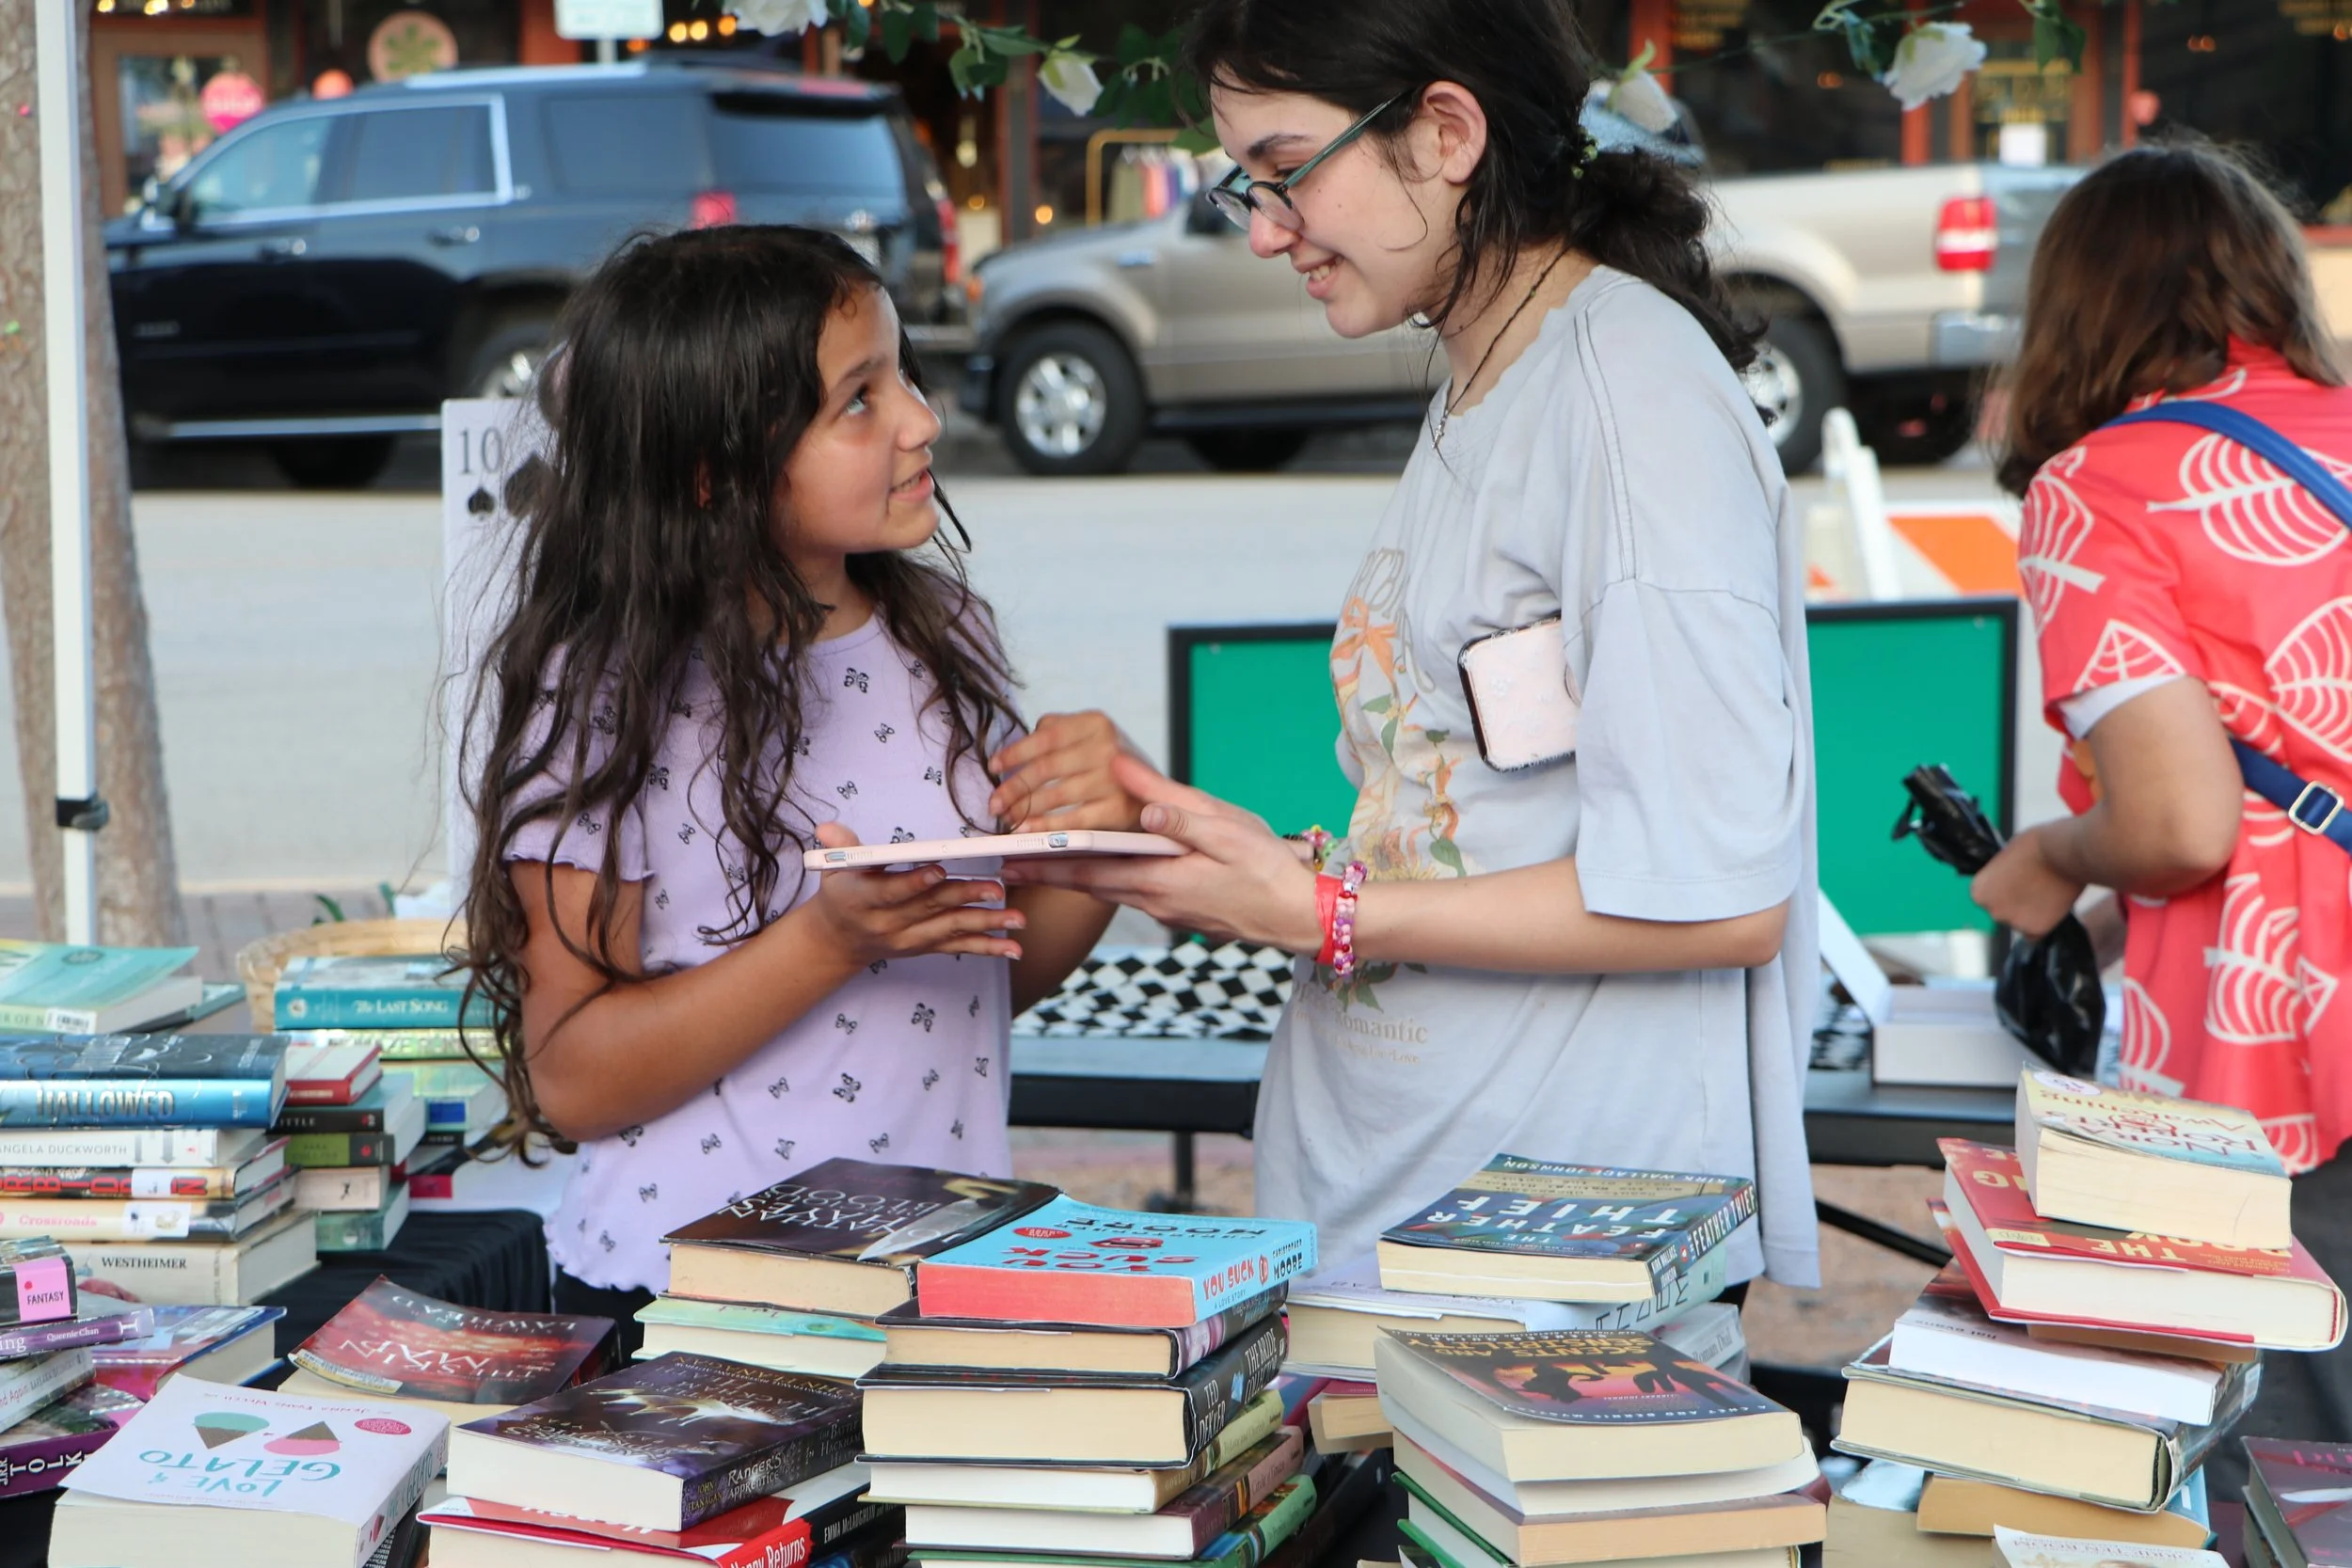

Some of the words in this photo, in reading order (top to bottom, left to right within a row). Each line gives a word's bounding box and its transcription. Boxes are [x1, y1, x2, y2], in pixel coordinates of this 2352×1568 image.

[459, 428, 502, 475] 10
[377, 1000, 405, 1014] LAST
[408, 998, 449, 1014] SONG
[36, 1087, 176, 1118] HALLOWED
[48, 1145, 127, 1155] DUCKWORTH
[2077, 1124, 2230, 1157] NORA
[1503, 1159, 1586, 1175] JOHNSON
[1594, 1169, 1676, 1182] WALLACE
[1683, 1175, 1727, 1184] KIRK
[19, 1214, 97, 1227] Crossroads
[1456, 1196, 1680, 1225] THIEF
[1692, 1205, 1732, 1257] FEATHER
[1730, 1185, 1756, 1225] THIEF
[1065, 1216, 1267, 1235] MOORE
[1425, 1211, 1668, 1240] FEATHER
[1272, 1238, 1303, 1259] CHRISTOPHER
[1501, 1233, 1552, 1243] THE
[1001, 1245, 1200, 1264] SUCK
[2084, 1237, 2188, 1262] THE
[102, 1257, 186, 1270] WESTHEIMER
[1001, 1259, 1152, 1273] YOU
[1273, 1252, 1303, 1280] MOORE
[1203, 1272, 1225, 1301] YOU
[1227, 1257, 1255, 1289] SUCK
[27, 1291, 64, 1306] FANTASY
[1218, 1295, 1231, 1308] LOVE
[1232, 1289, 1247, 1301] STORY
[47, 1329, 78, 1342] Queenie
[79, 1327, 99, 1338] Chan
[1405, 1338, 1655, 1350] SENSIBILITY
[361, 1339, 491, 1370] MAP
[1245, 1343, 1260, 1375] THE
[1257, 1327, 1278, 1365] BRIDE
[1433, 1348, 1493, 1356] AND
[1511, 1345, 1647, 1357] SCENTS
[1203, 1378, 1220, 1409] TED
[1199, 1400, 1226, 1449] DEKKER
[139, 1449, 342, 1481] GELATO
[727, 1451, 782, 1488] RANGER'S
[189, 1476, 282, 1497] LOVE
[697, 1481, 715, 1495] JOHN
[726, 1469, 780, 1501] APPRENTICE
[687, 1491, 723, 1513] FLANAGAN
[824, 1523, 842, 1544] EMMA
[842, 1504, 876, 1537] McLAUGHLIN
[765, 1537, 805, 1568] Returns
